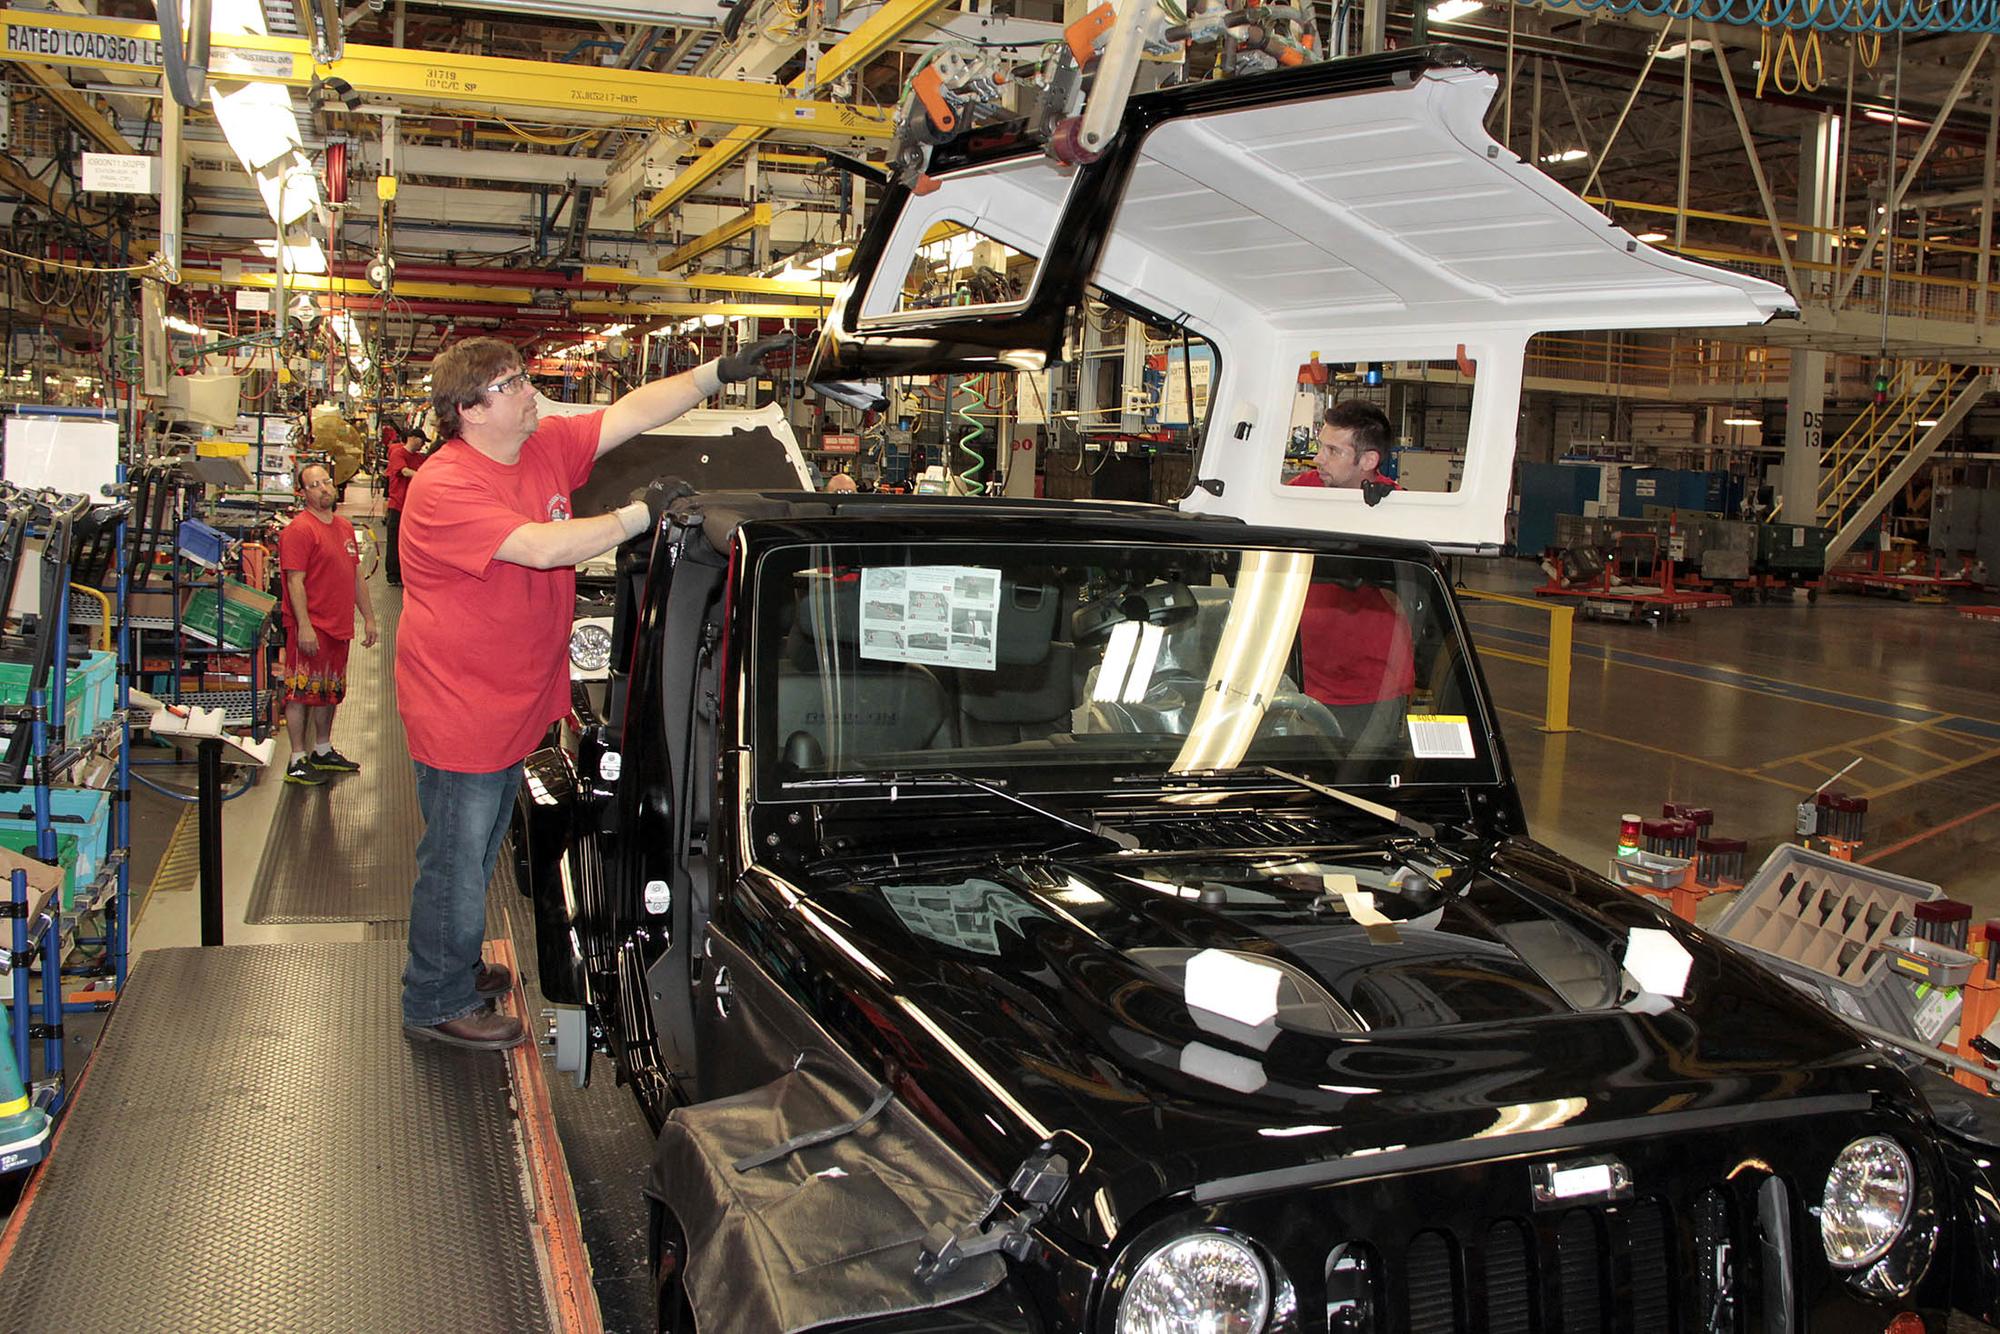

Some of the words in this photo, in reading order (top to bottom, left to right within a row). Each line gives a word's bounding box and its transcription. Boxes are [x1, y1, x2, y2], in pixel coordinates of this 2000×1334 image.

[8, 24, 60, 54] RATED
[65, 31, 107, 59] LOAD
[107, 37, 137, 63] 350
[1804, 411, 1823, 429] D5
[1805, 431, 1820, 447] 13
